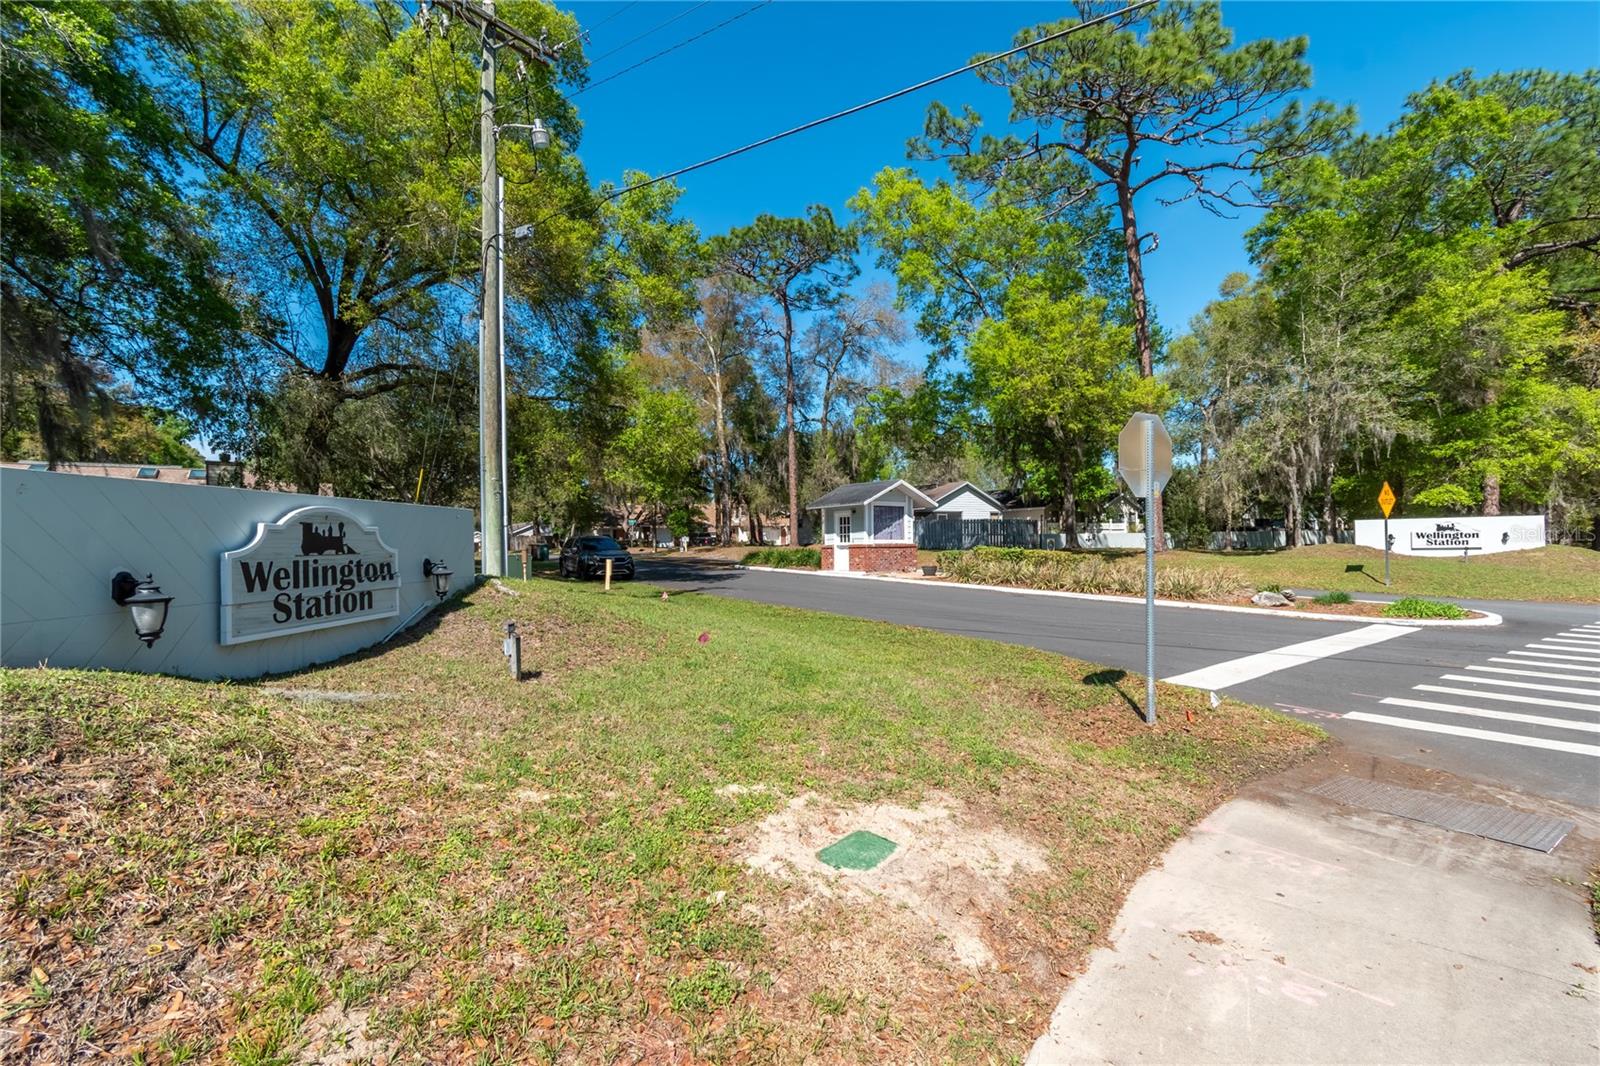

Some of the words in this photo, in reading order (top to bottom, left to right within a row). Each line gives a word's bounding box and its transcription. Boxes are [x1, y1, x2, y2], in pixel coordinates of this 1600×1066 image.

[1416, 531, 1480, 541] Wellington
[239, 558, 395, 592] Wellington
[273, 590, 374, 624] Station
